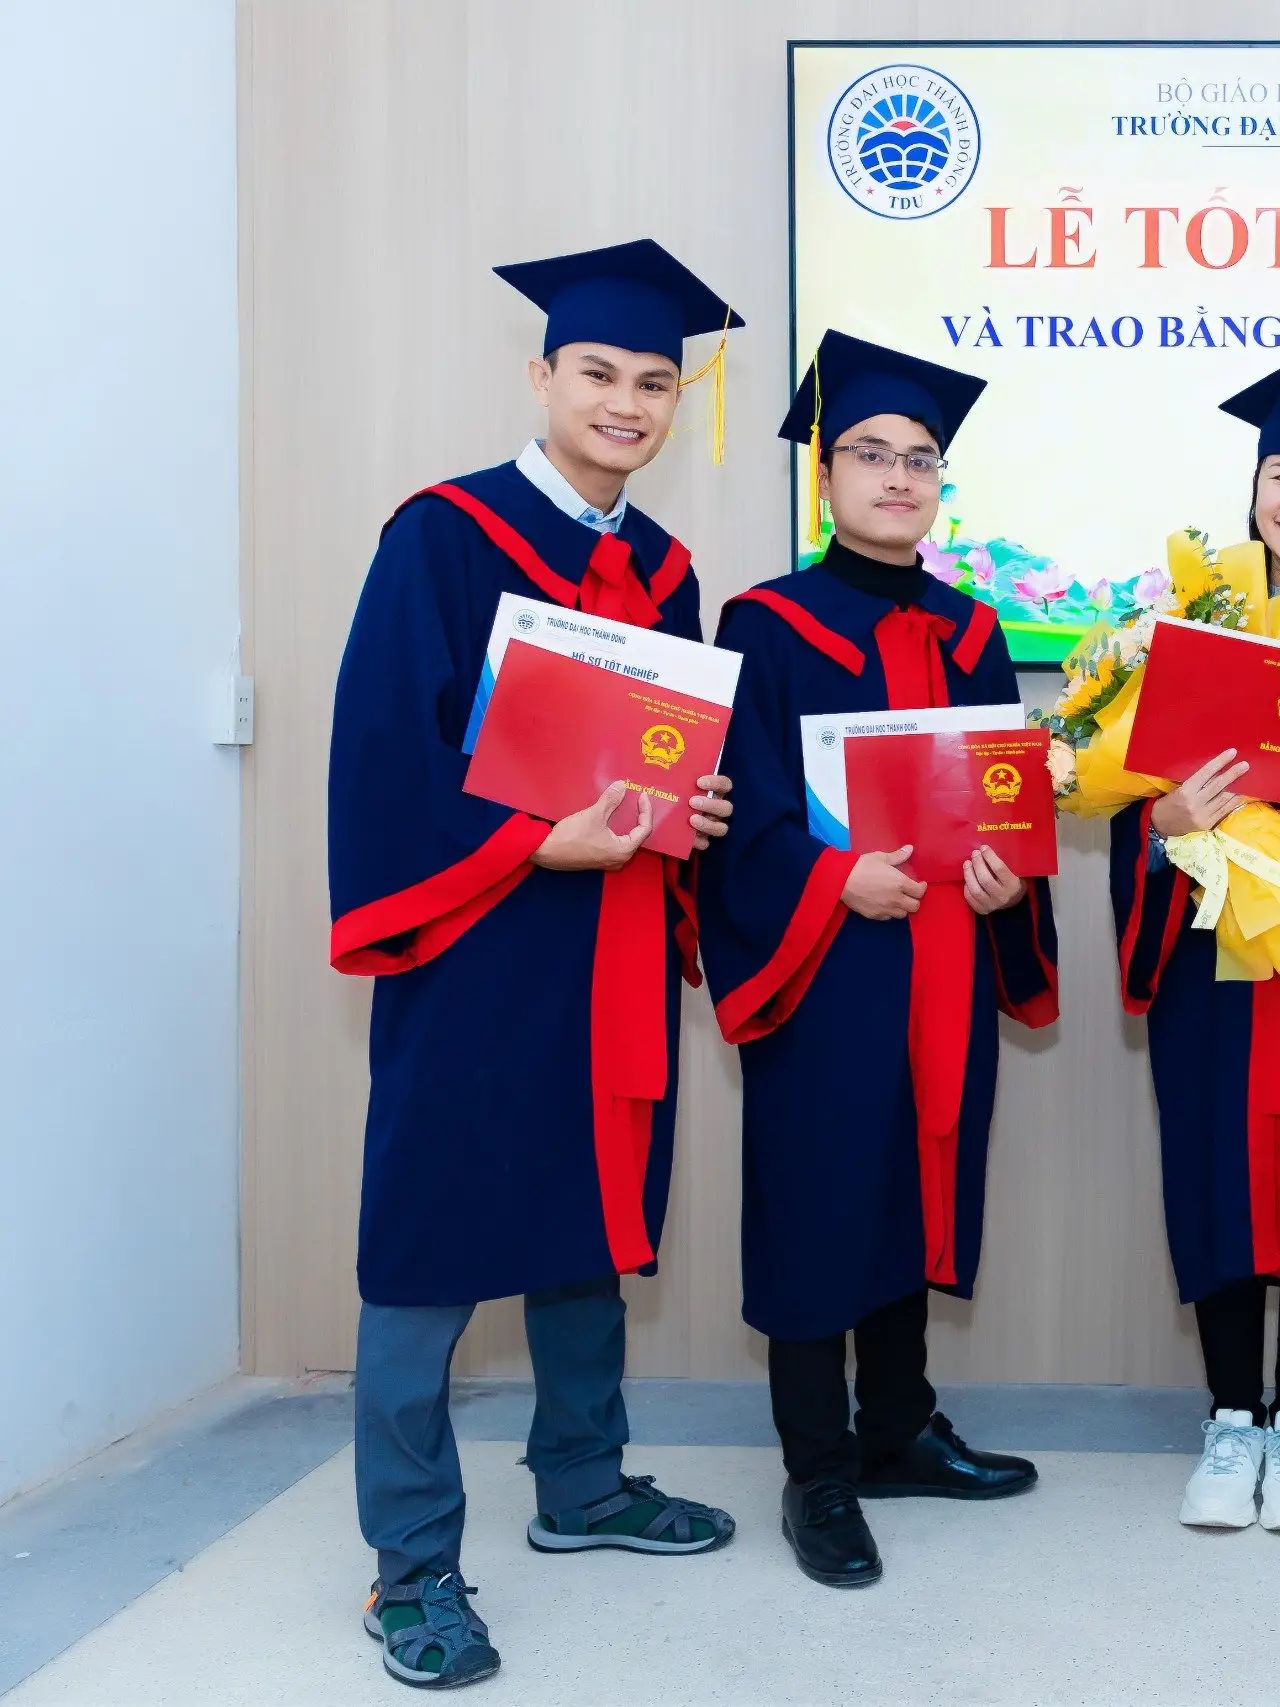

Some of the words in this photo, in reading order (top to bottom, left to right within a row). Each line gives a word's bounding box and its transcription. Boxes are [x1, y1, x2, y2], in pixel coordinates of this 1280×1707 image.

[850, 83, 879, 110] ĐẠI
[883, 74, 920, 89] HỌC
[1157, 77, 1193, 107] BỘ
[1201, 77, 1268, 103] GIÁO
[926, 79, 969, 132] THÀNH
[1112, 110, 1231, 136] TRƯỜNG
[835, 113, 862, 188] TRƯỜNG
[945, 138, 972, 188] ĐÔNG
[888, 195, 924, 210] TDU
[984, 186, 1097, 269] LỄ
[941, 306, 1004, 348] VÀ
[1016, 315, 1144, 348] TRAO
[623, 665, 659, 681] NGHIỆP
